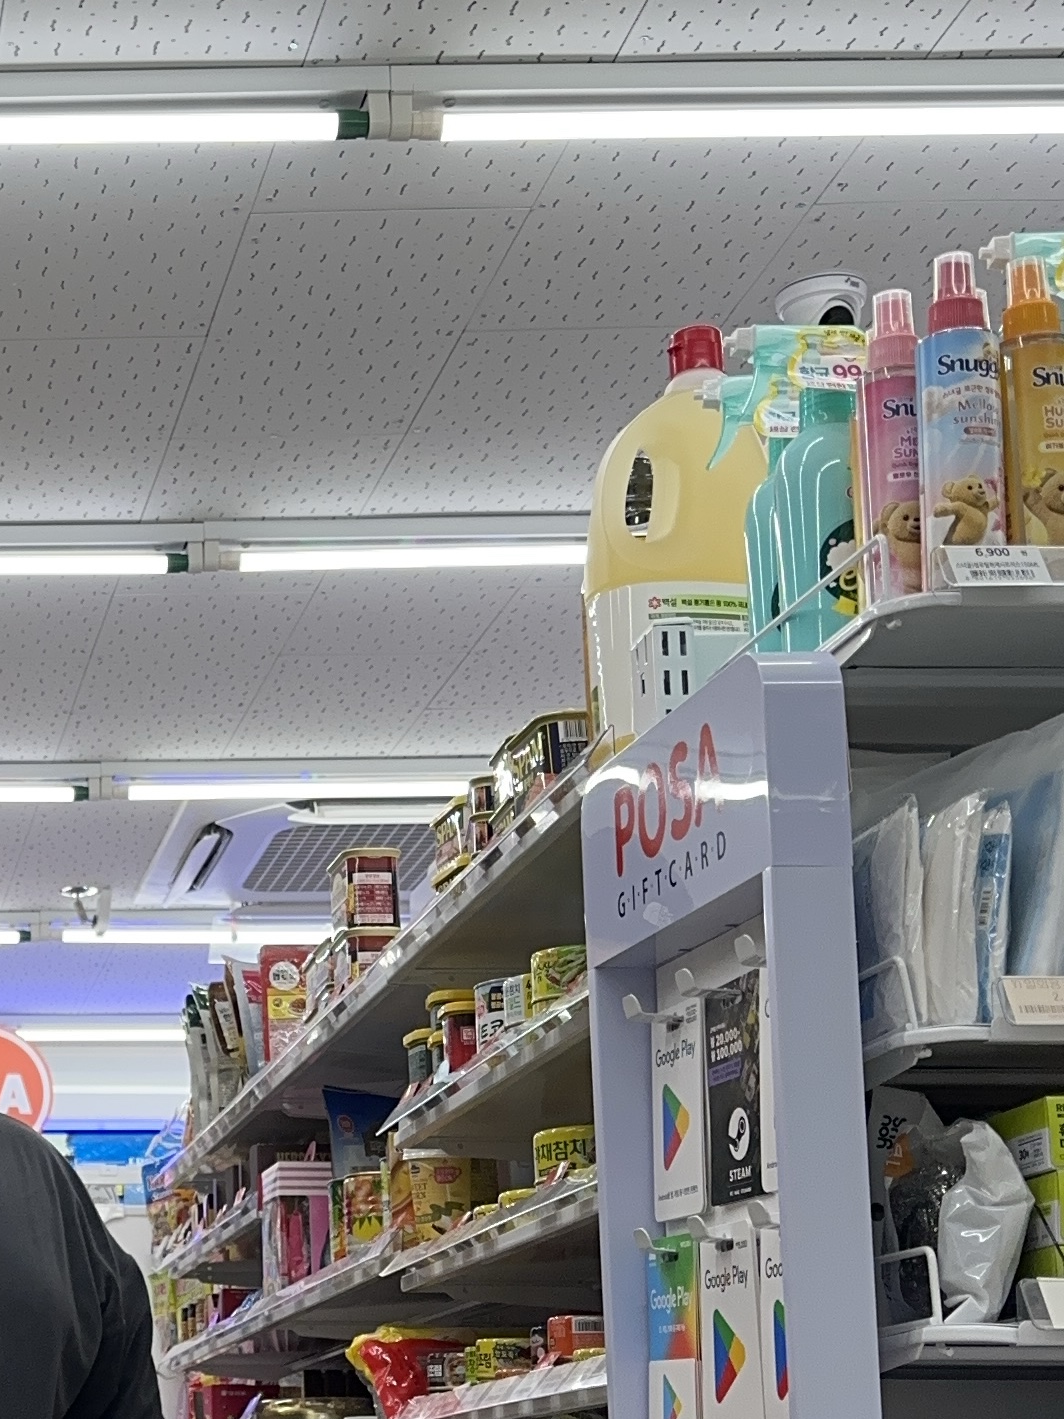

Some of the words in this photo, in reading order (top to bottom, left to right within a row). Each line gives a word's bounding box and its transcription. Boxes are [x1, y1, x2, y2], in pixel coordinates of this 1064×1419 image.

[958, 399, 995, 412] Mello
[613, 722, 725, 878] POSA
[655, 1047, 680, 1069] Google
[680, 1038, 696, 1060] Play
[728, 1165, 752, 1182] STEAM
[704, 1268, 731, 1293] Google
[732, 1265, 748, 1289] Play
[650, 1288, 677, 1315] Google
